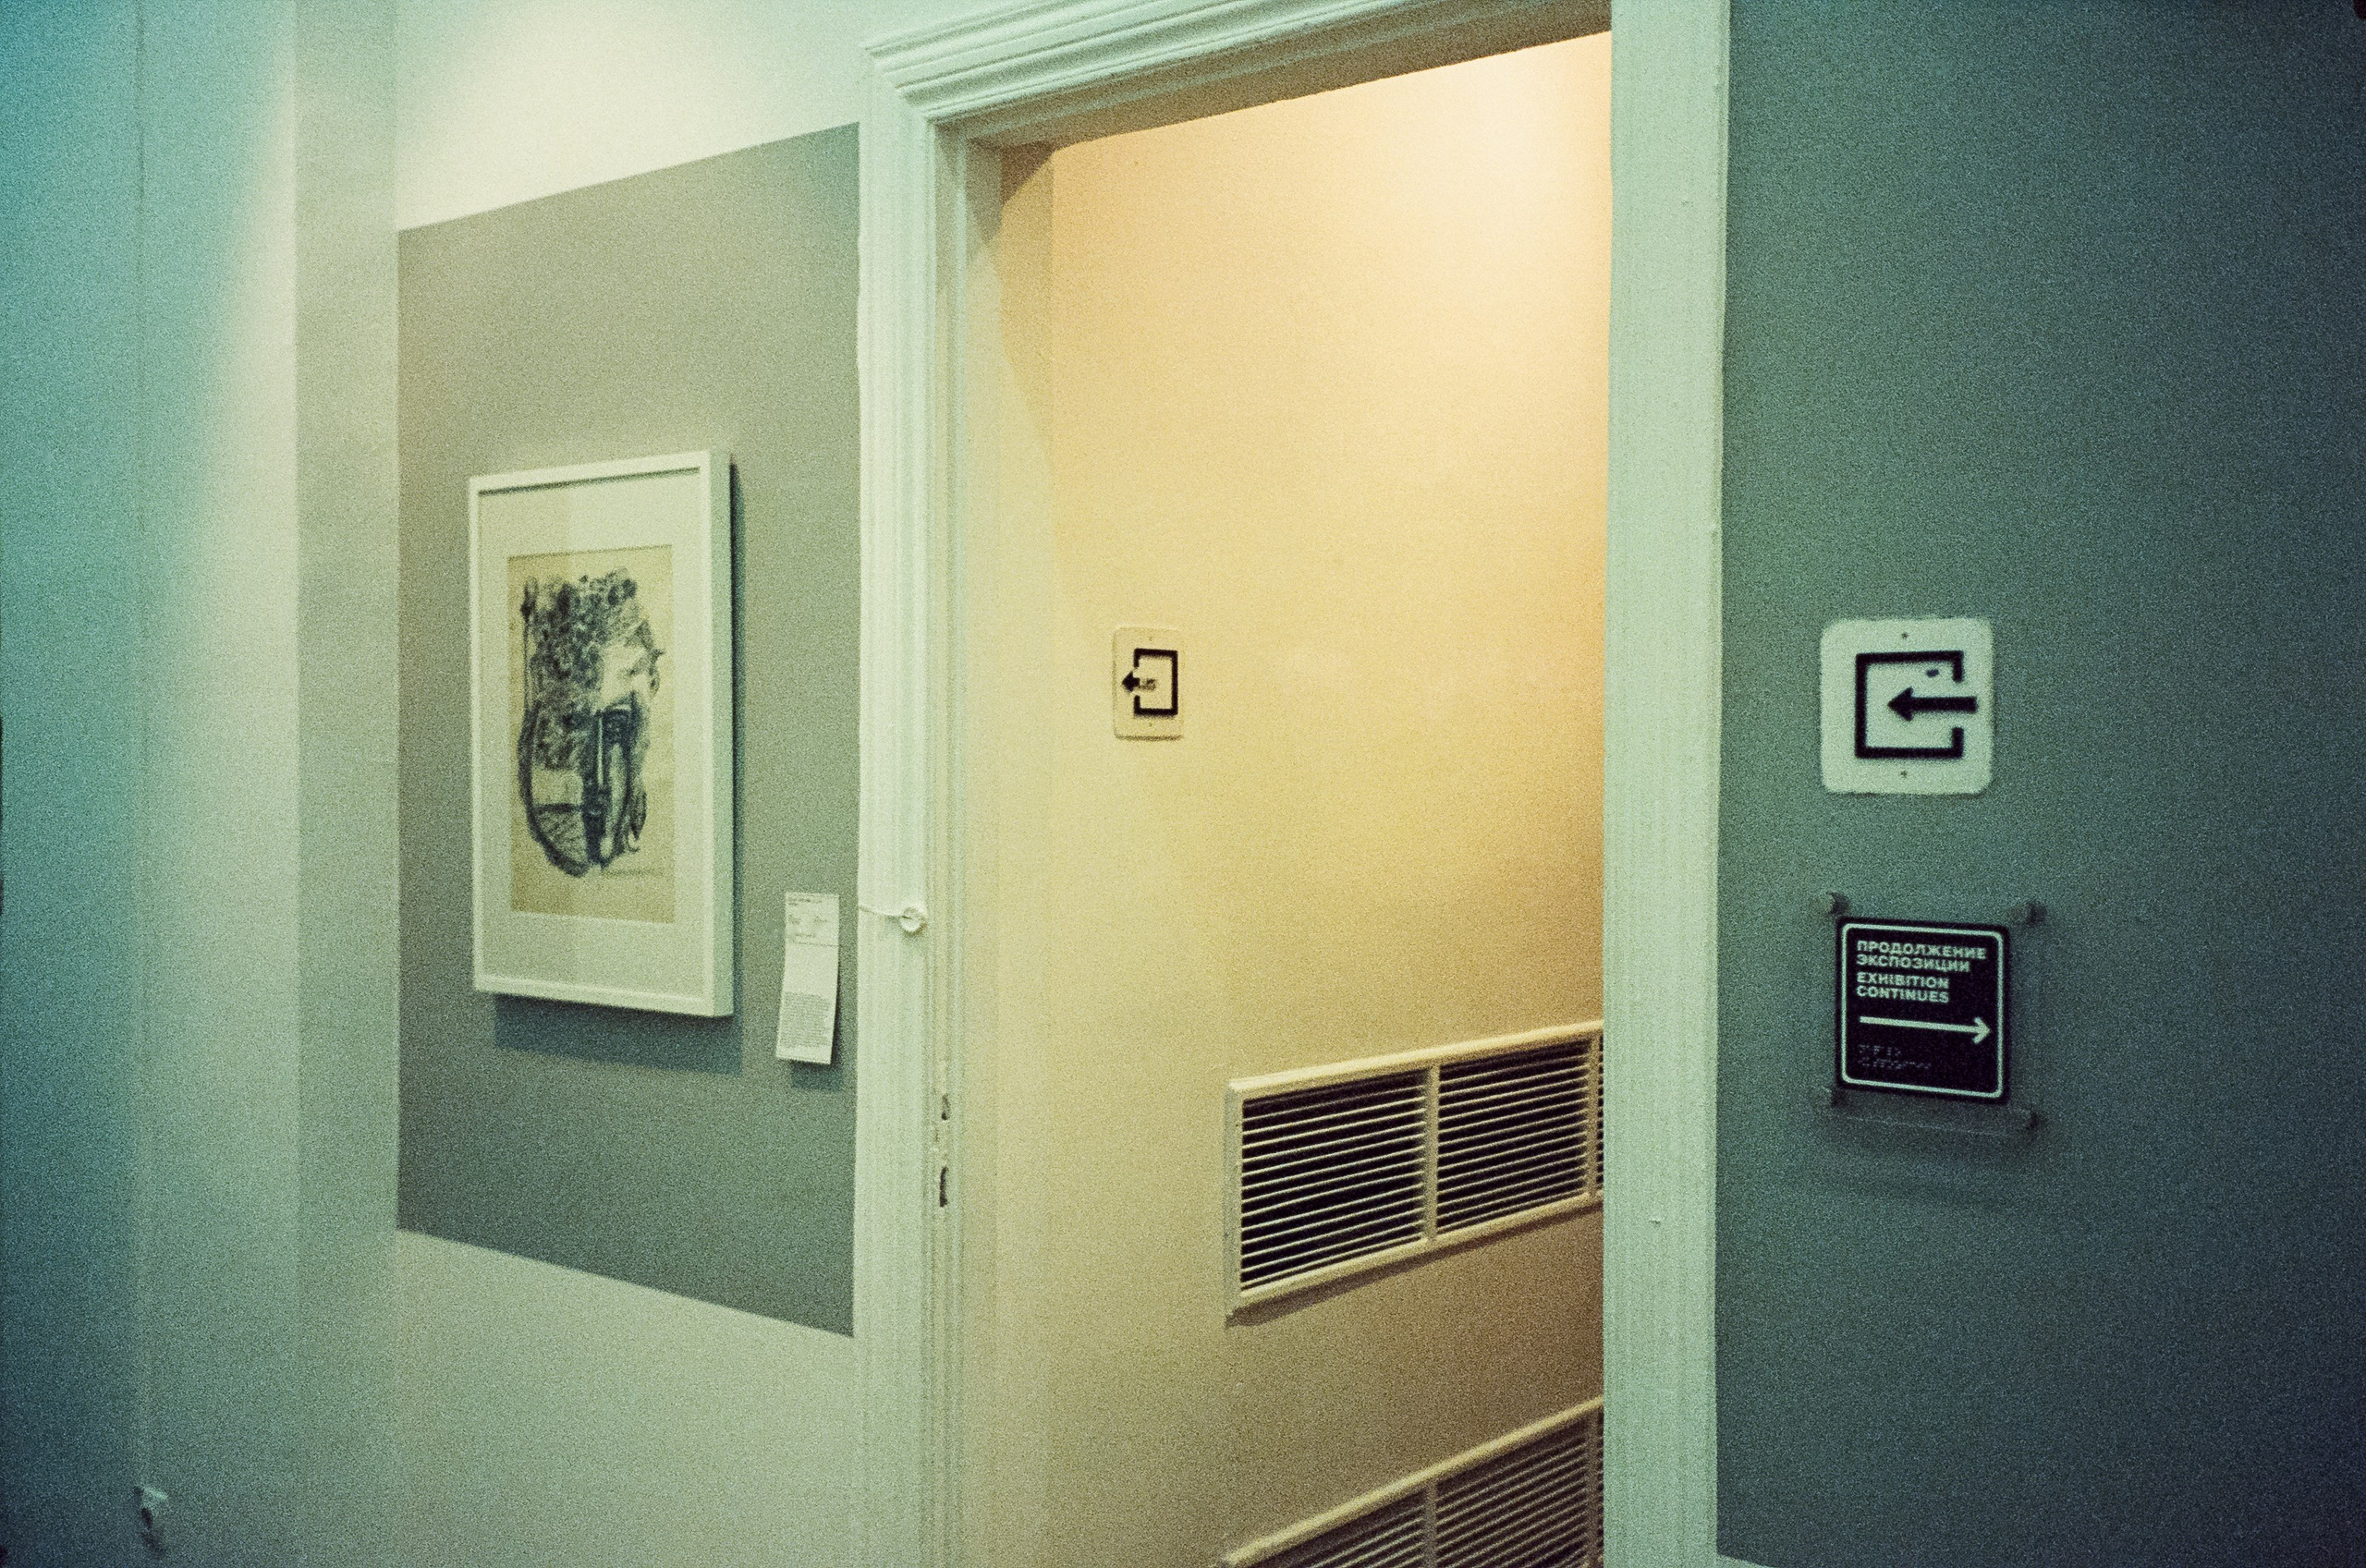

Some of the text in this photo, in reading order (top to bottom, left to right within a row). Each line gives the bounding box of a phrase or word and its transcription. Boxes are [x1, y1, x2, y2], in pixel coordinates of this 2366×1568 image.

[1857, 940, 1986, 959] ПРОДОЛЖЕНИЕ
[1856, 954, 1970, 972] ЭКСПОЗИЦИИ
[1857, 971, 1949, 990] EXHIBITION
[1856, 985, 1949, 1003] CONTINUES
